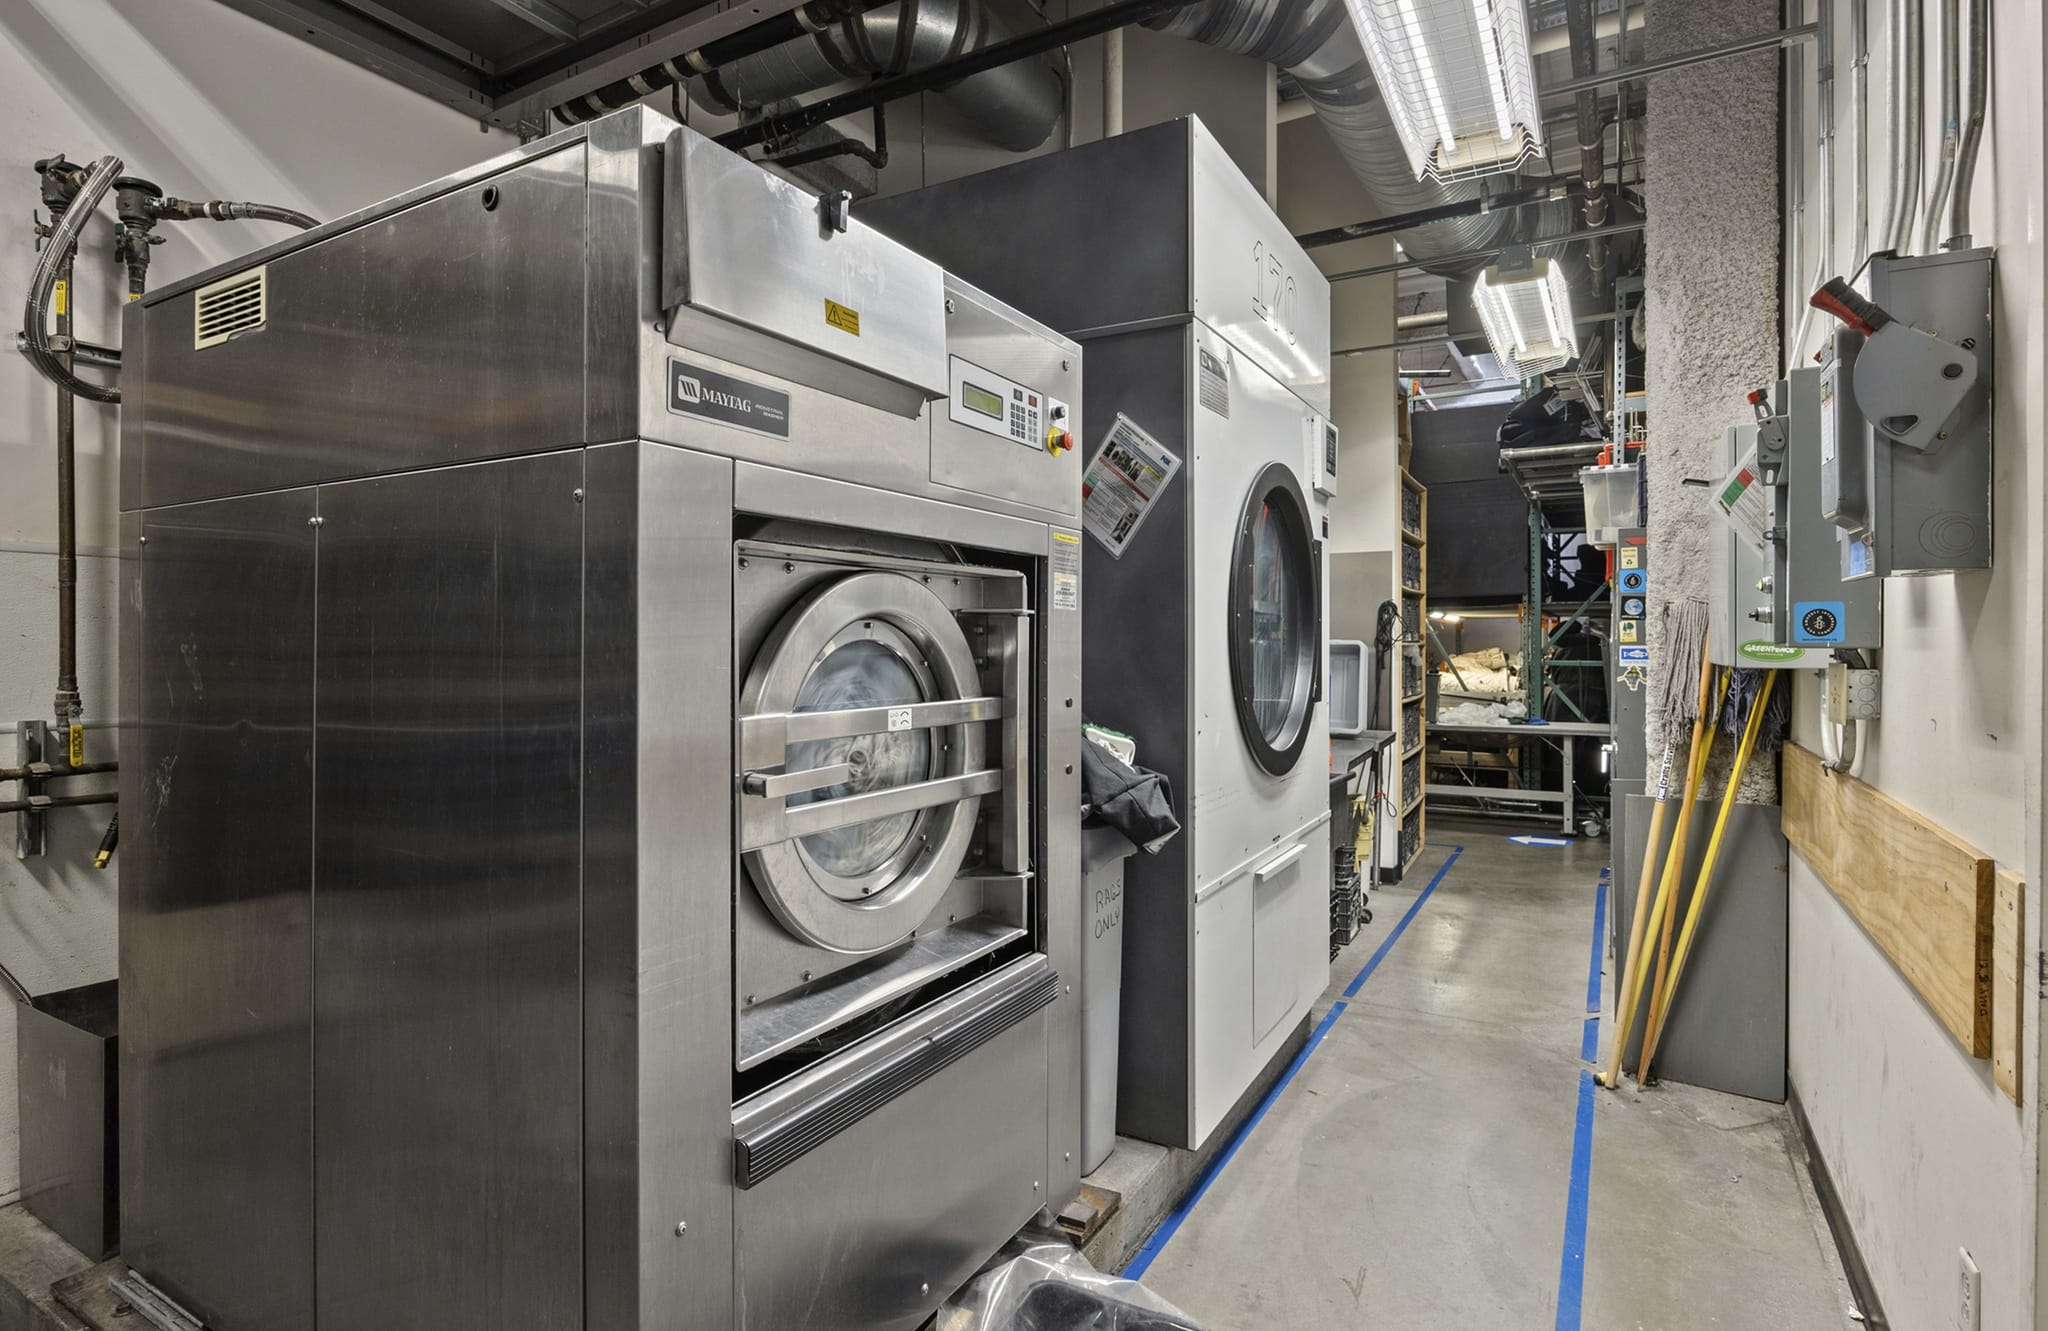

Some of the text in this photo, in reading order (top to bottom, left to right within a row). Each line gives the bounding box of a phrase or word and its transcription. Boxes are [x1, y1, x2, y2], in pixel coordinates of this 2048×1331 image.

[702, 387, 751, 413] MAYTAG
[1095, 878, 1121, 914] RAGS
[1093, 906, 1120, 940] ONLY
